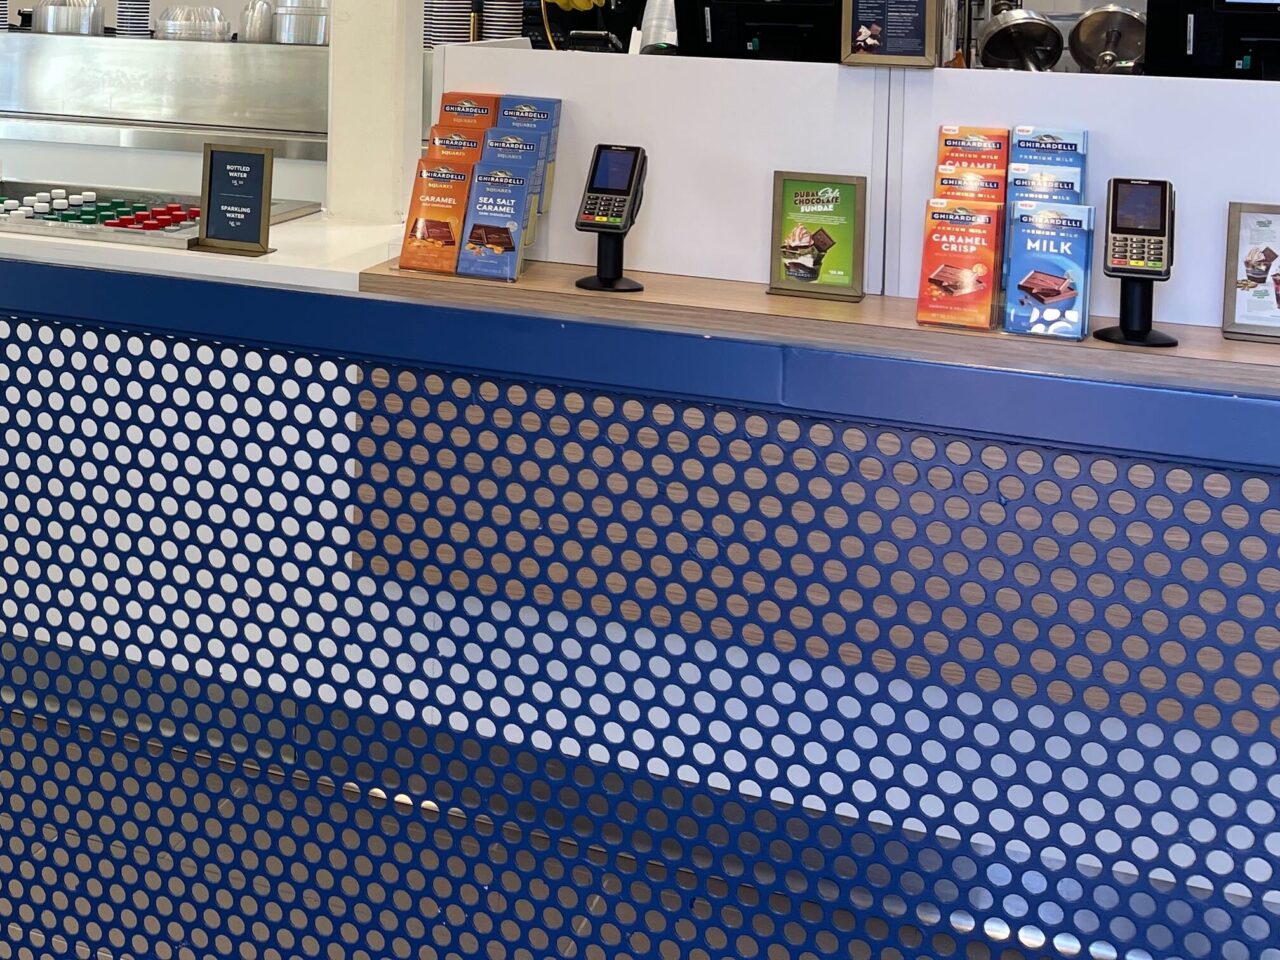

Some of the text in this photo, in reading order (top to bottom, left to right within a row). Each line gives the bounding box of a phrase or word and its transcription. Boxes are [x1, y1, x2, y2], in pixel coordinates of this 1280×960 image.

[445, 106, 488, 115] GHIRARDELLI
[503, 109, 548, 120] GHIRARDELLI
[488, 141, 534, 151] GHIRARDELLI
[946, 140, 1001, 150] GHIRARDELLI
[1019, 140, 1077, 151] GHIRARDELLI
[226, 164, 251, 172] BOTTLED
[478, 175, 523, 185] GHIRARDELLI
[1015, 179, 1072, 190] GHIRARDELLI
[419, 194, 457, 205] CARAMEL
[794, 191, 819, 199] DUBAI
[478, 196, 516, 206] SEA SALT
[793, 196, 840, 206] CHOCOLATE
[220, 205, 251, 214] SPARKLING
[476, 204, 516, 214] CARAMEL
[800, 204, 834, 213] SUNDAE
[1021, 215, 1081, 228] GHIRARDELLI
[932, 233, 988, 246] CARAMEL
[941, 243, 977, 254] CRISP
[1026, 238, 1073, 255] MILK
